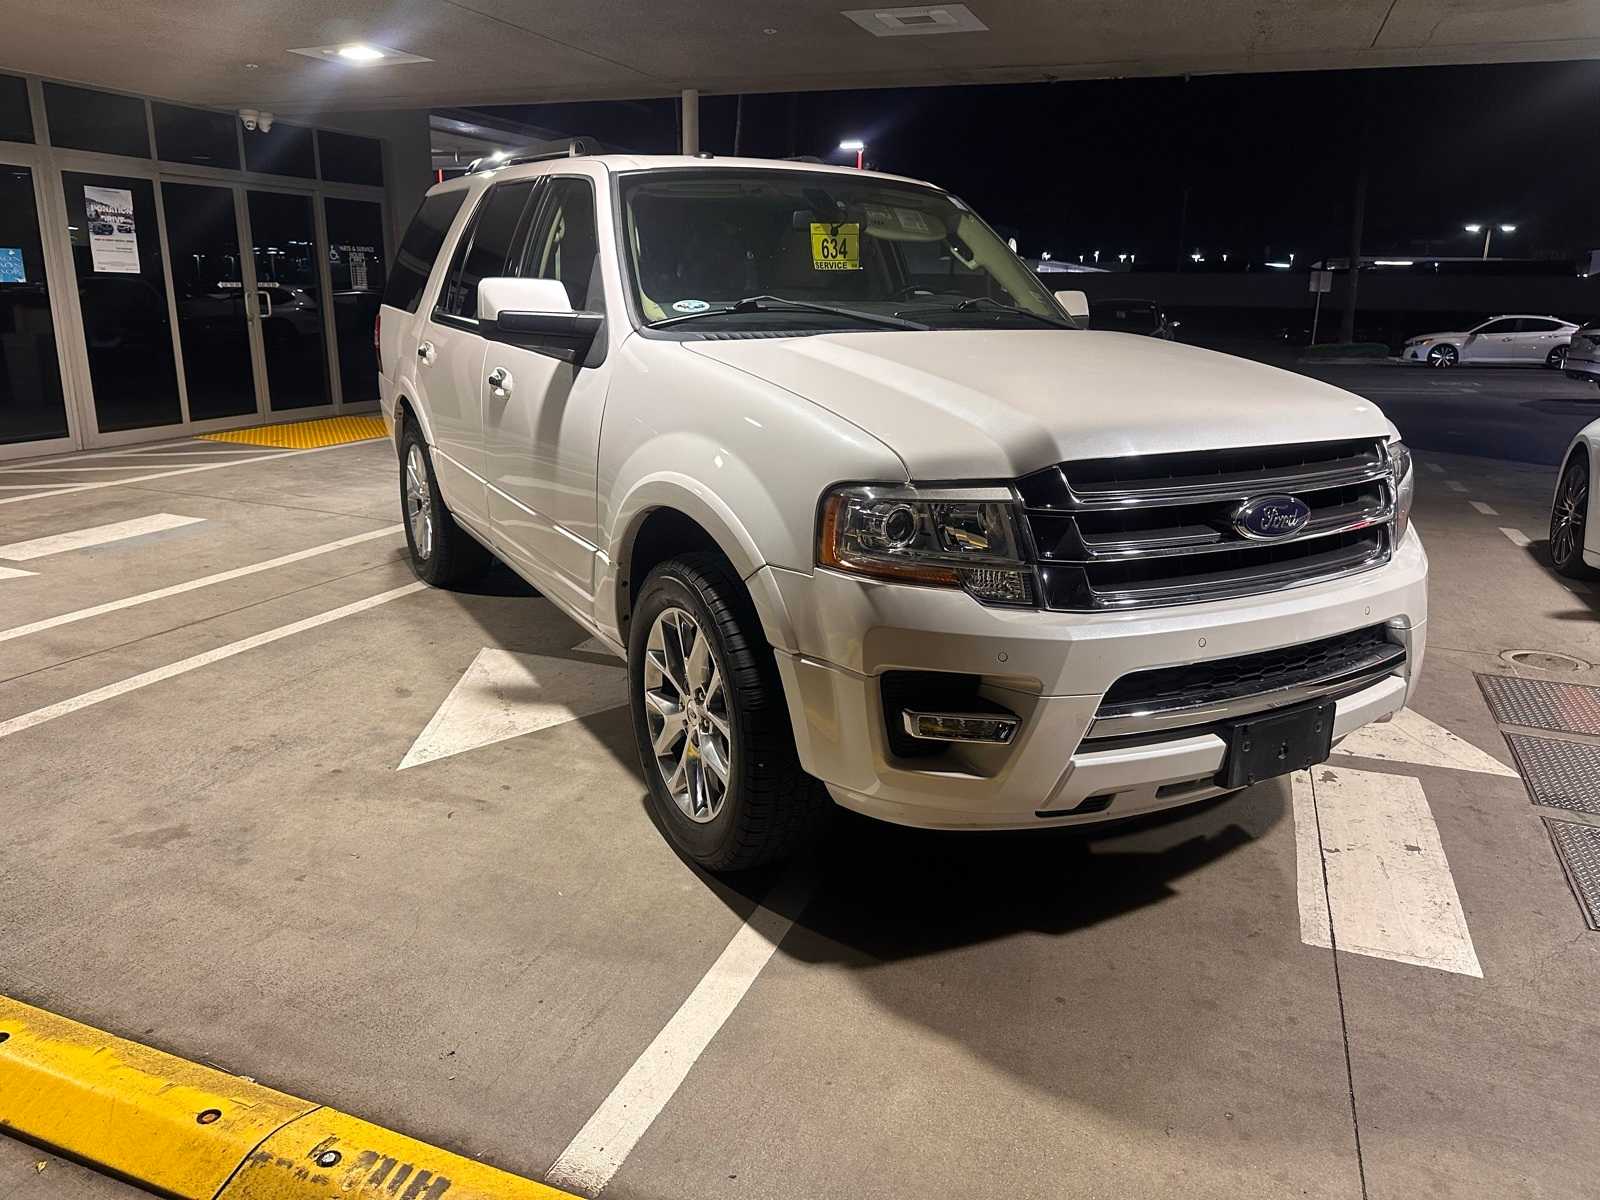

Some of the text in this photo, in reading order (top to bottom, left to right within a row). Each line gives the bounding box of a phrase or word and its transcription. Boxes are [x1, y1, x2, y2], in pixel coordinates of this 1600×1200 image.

[821, 237, 848, 259] 634
[815, 261, 848, 269] SERVICE
[1260, 505, 1299, 530] Ford
